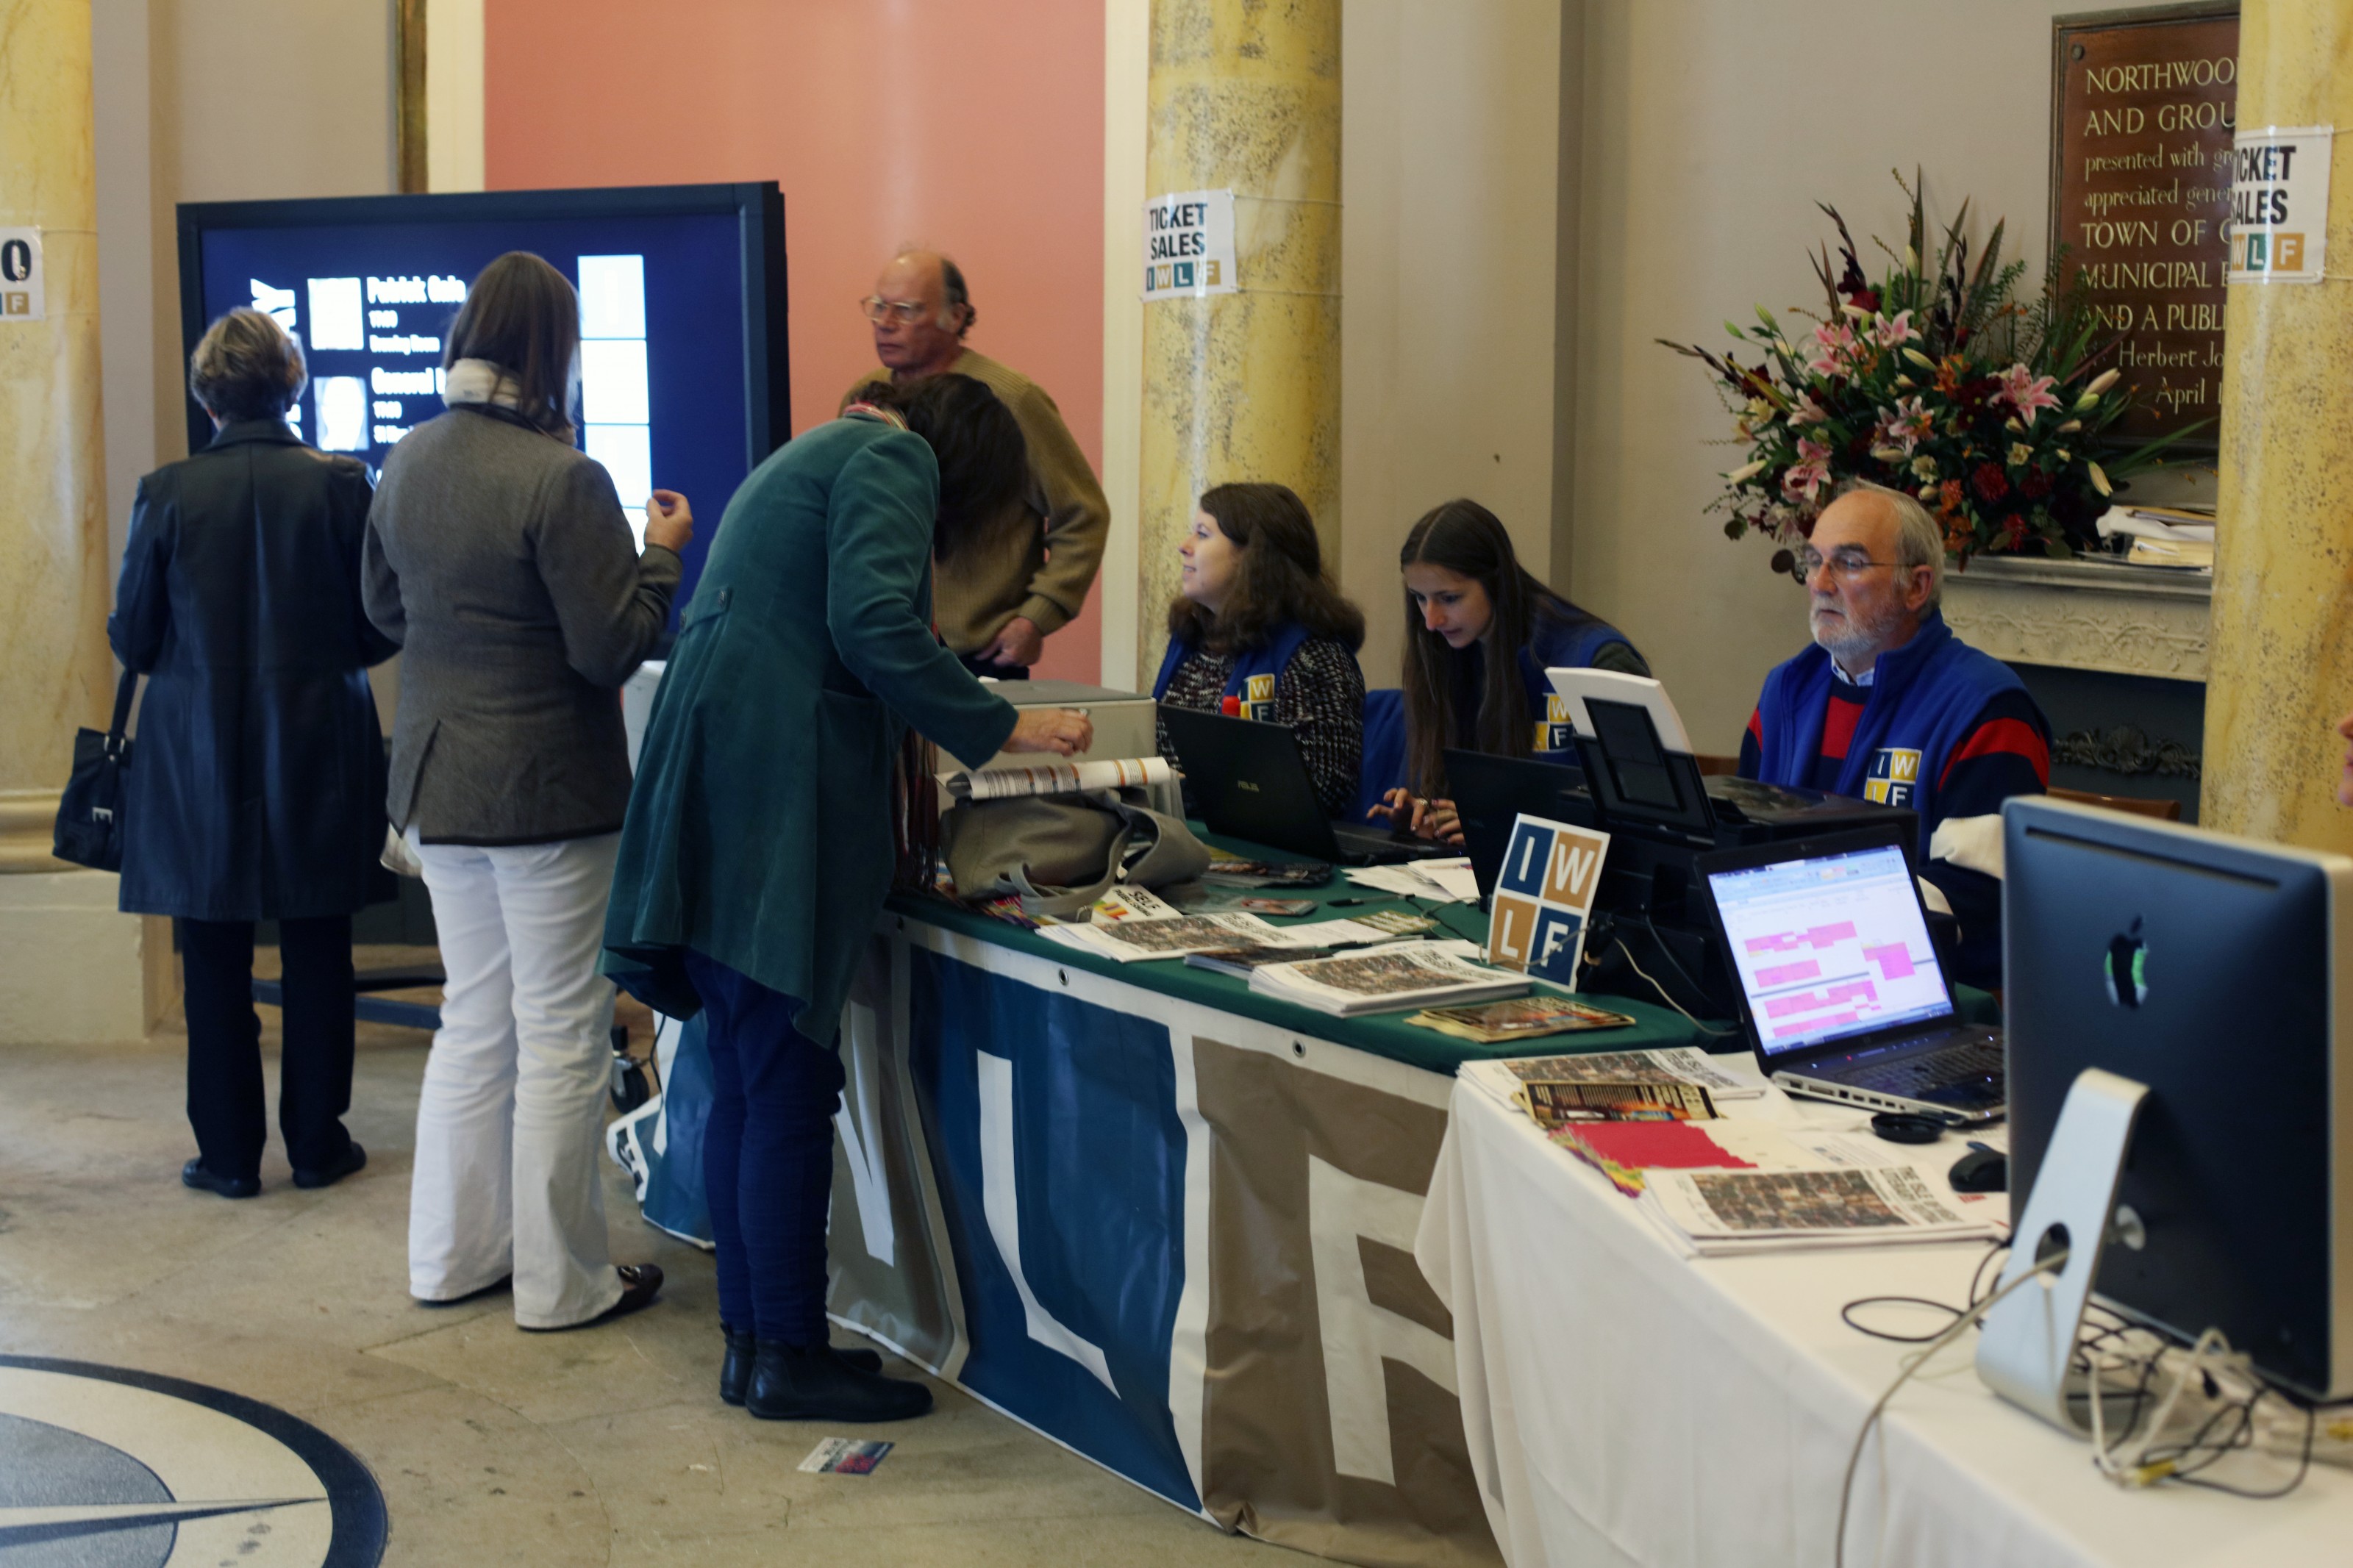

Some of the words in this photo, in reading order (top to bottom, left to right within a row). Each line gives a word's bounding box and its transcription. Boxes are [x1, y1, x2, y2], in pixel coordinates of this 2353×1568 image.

[2086, 57, 2238, 94] NORTHWOO
[2085, 107, 2145, 137] AND
[2085, 143, 2163, 182] presented
[2171, 141, 2204, 168] with
[2085, 177, 2178, 216] appreciated
[1150, 202, 1208, 232] TICKET
[1151, 232, 1206, 260] SALES
[2080, 221, 2159, 248] TOWN
[2171, 219, 2207, 246] OF
[2081, 261, 2212, 290] MUNICIPAL
[2141, 304, 2160, 331] A
[2118, 340, 2198, 368] Herbert
[2155, 376, 2205, 413] April
[1128, 889, 1161, 909] SELF
